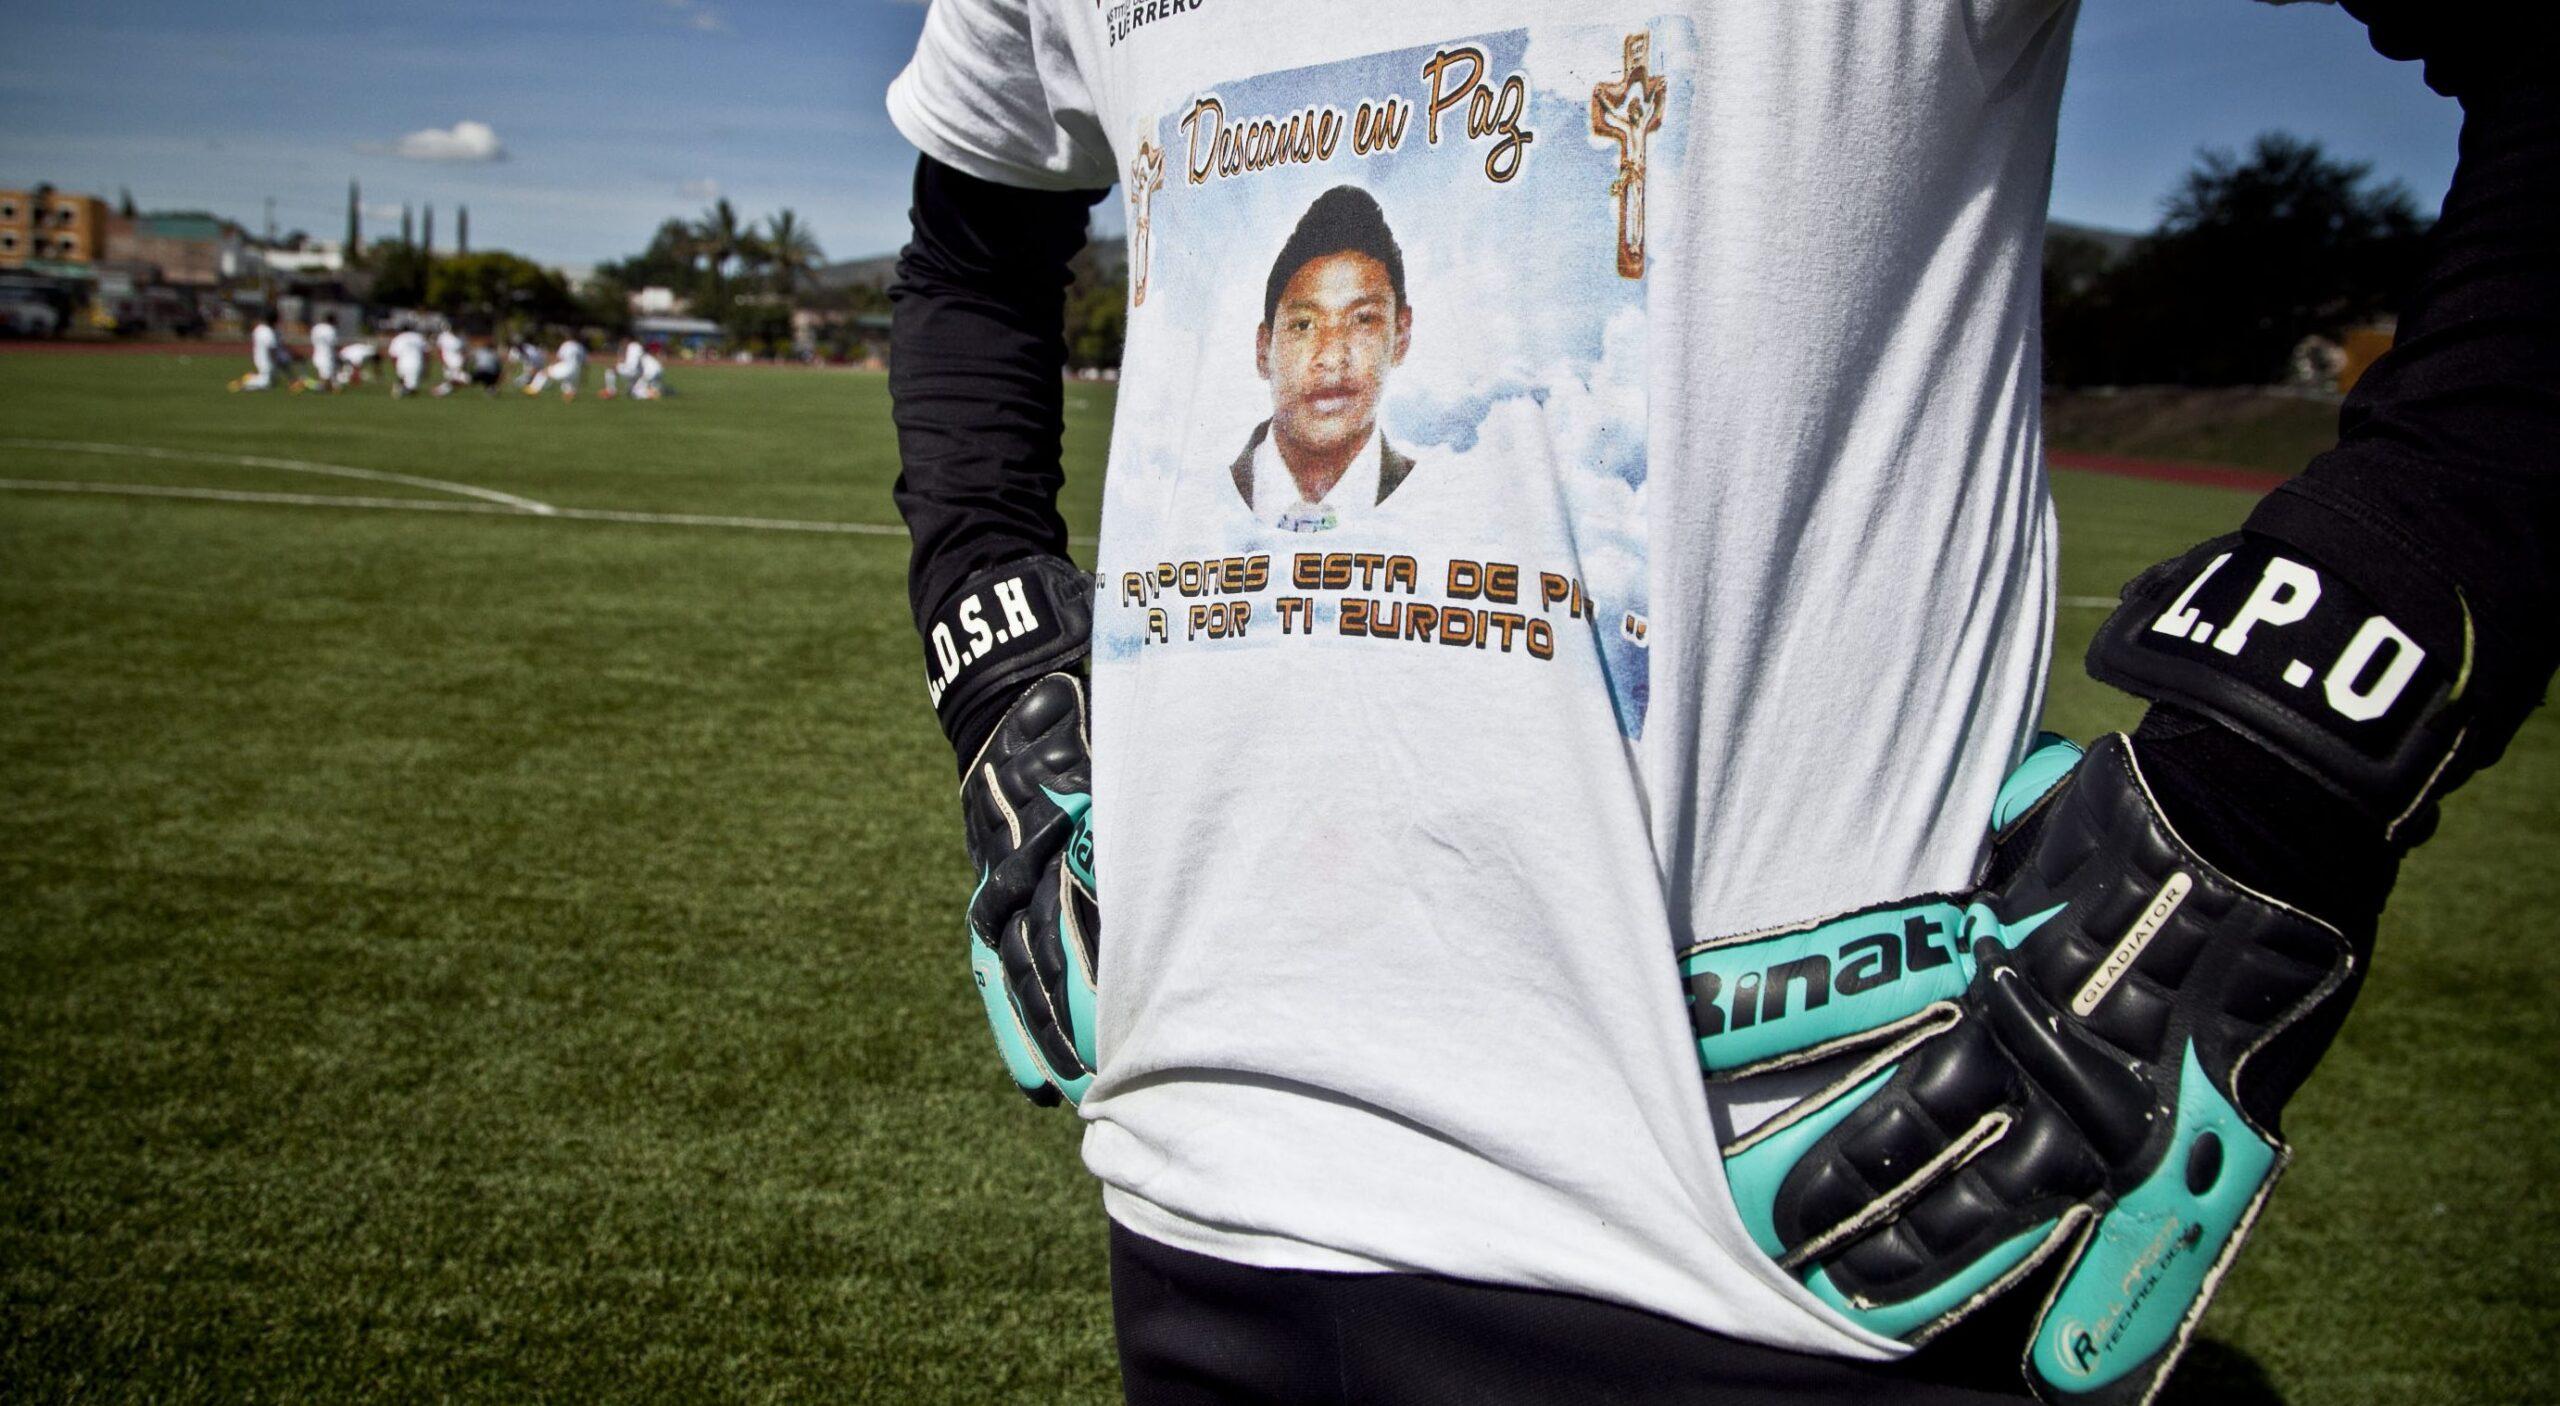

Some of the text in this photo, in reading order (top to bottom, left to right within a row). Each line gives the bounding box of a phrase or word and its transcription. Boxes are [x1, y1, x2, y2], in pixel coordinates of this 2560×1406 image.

[1181, 46, 1534, 185] Descanse en Paz
[1144, 596, 1555, 662] A POR TI ZURDITO
[1293, 552, 1418, 595] ESTA
[1446, 559, 1519, 605] DE
[1539, 571, 1595, 626] PI
[2151, 552, 2427, 722] L.P.O
[2083, 887, 2181, 1004] GLADIATOR
